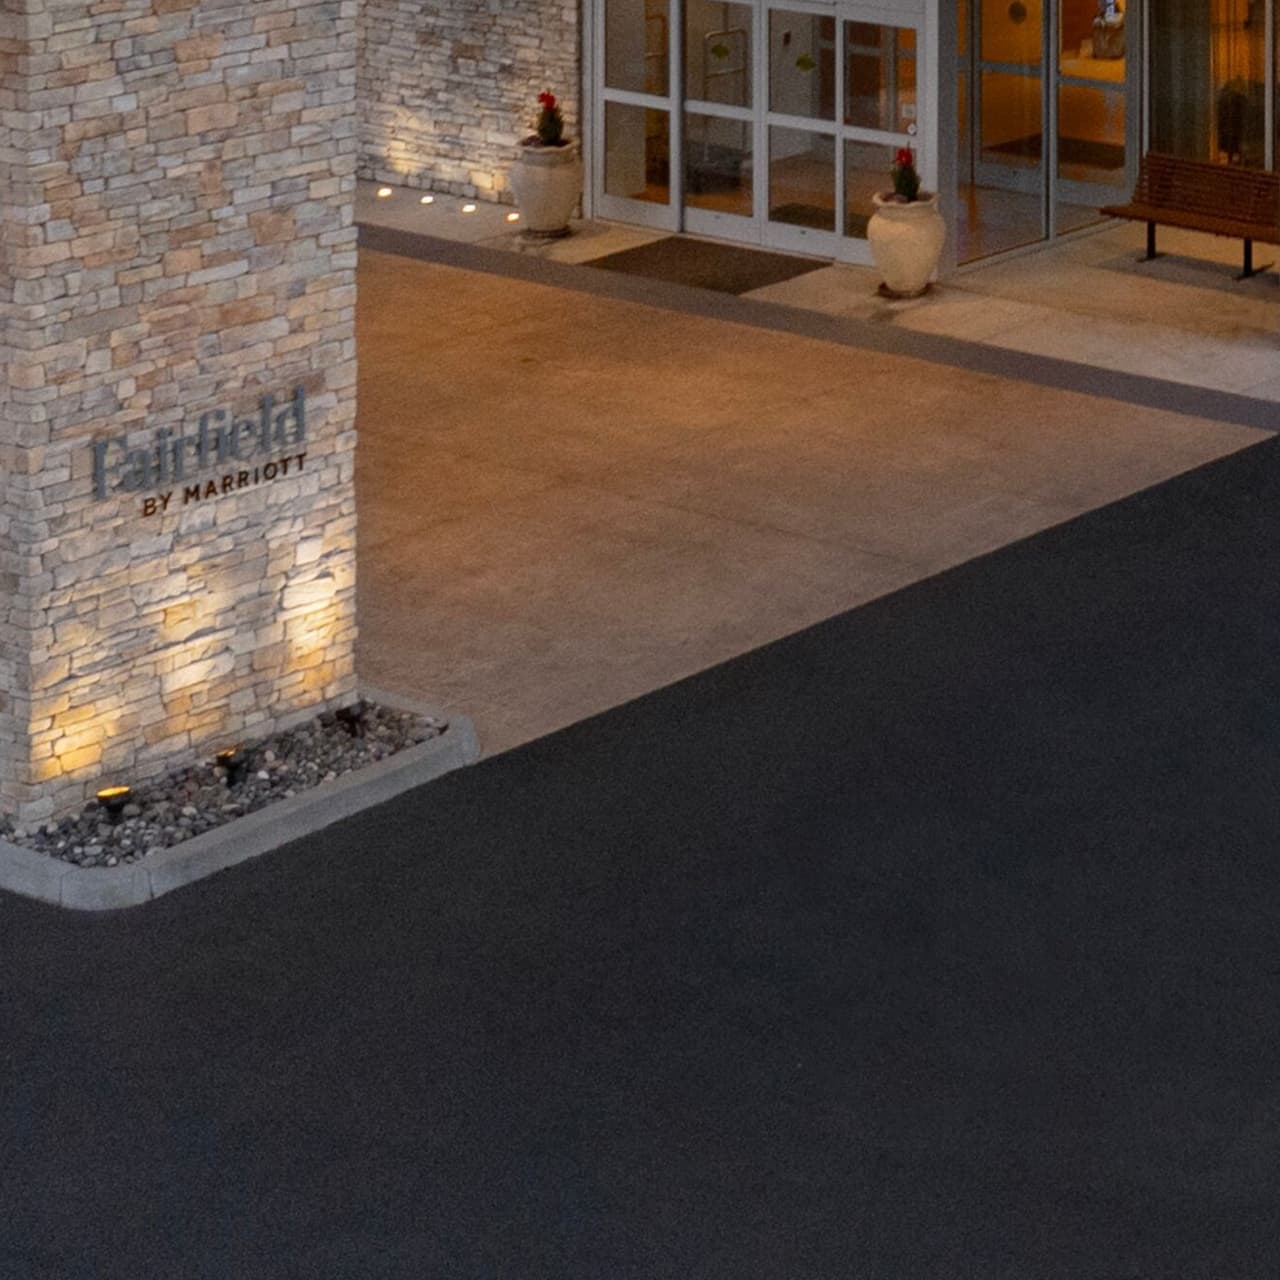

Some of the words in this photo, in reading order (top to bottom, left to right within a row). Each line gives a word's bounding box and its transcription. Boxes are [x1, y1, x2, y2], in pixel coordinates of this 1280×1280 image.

[92, 384, 308, 501] Fairfield
[142, 492, 172, 518] BY
[183, 452, 308, 505] MARRIOTT
